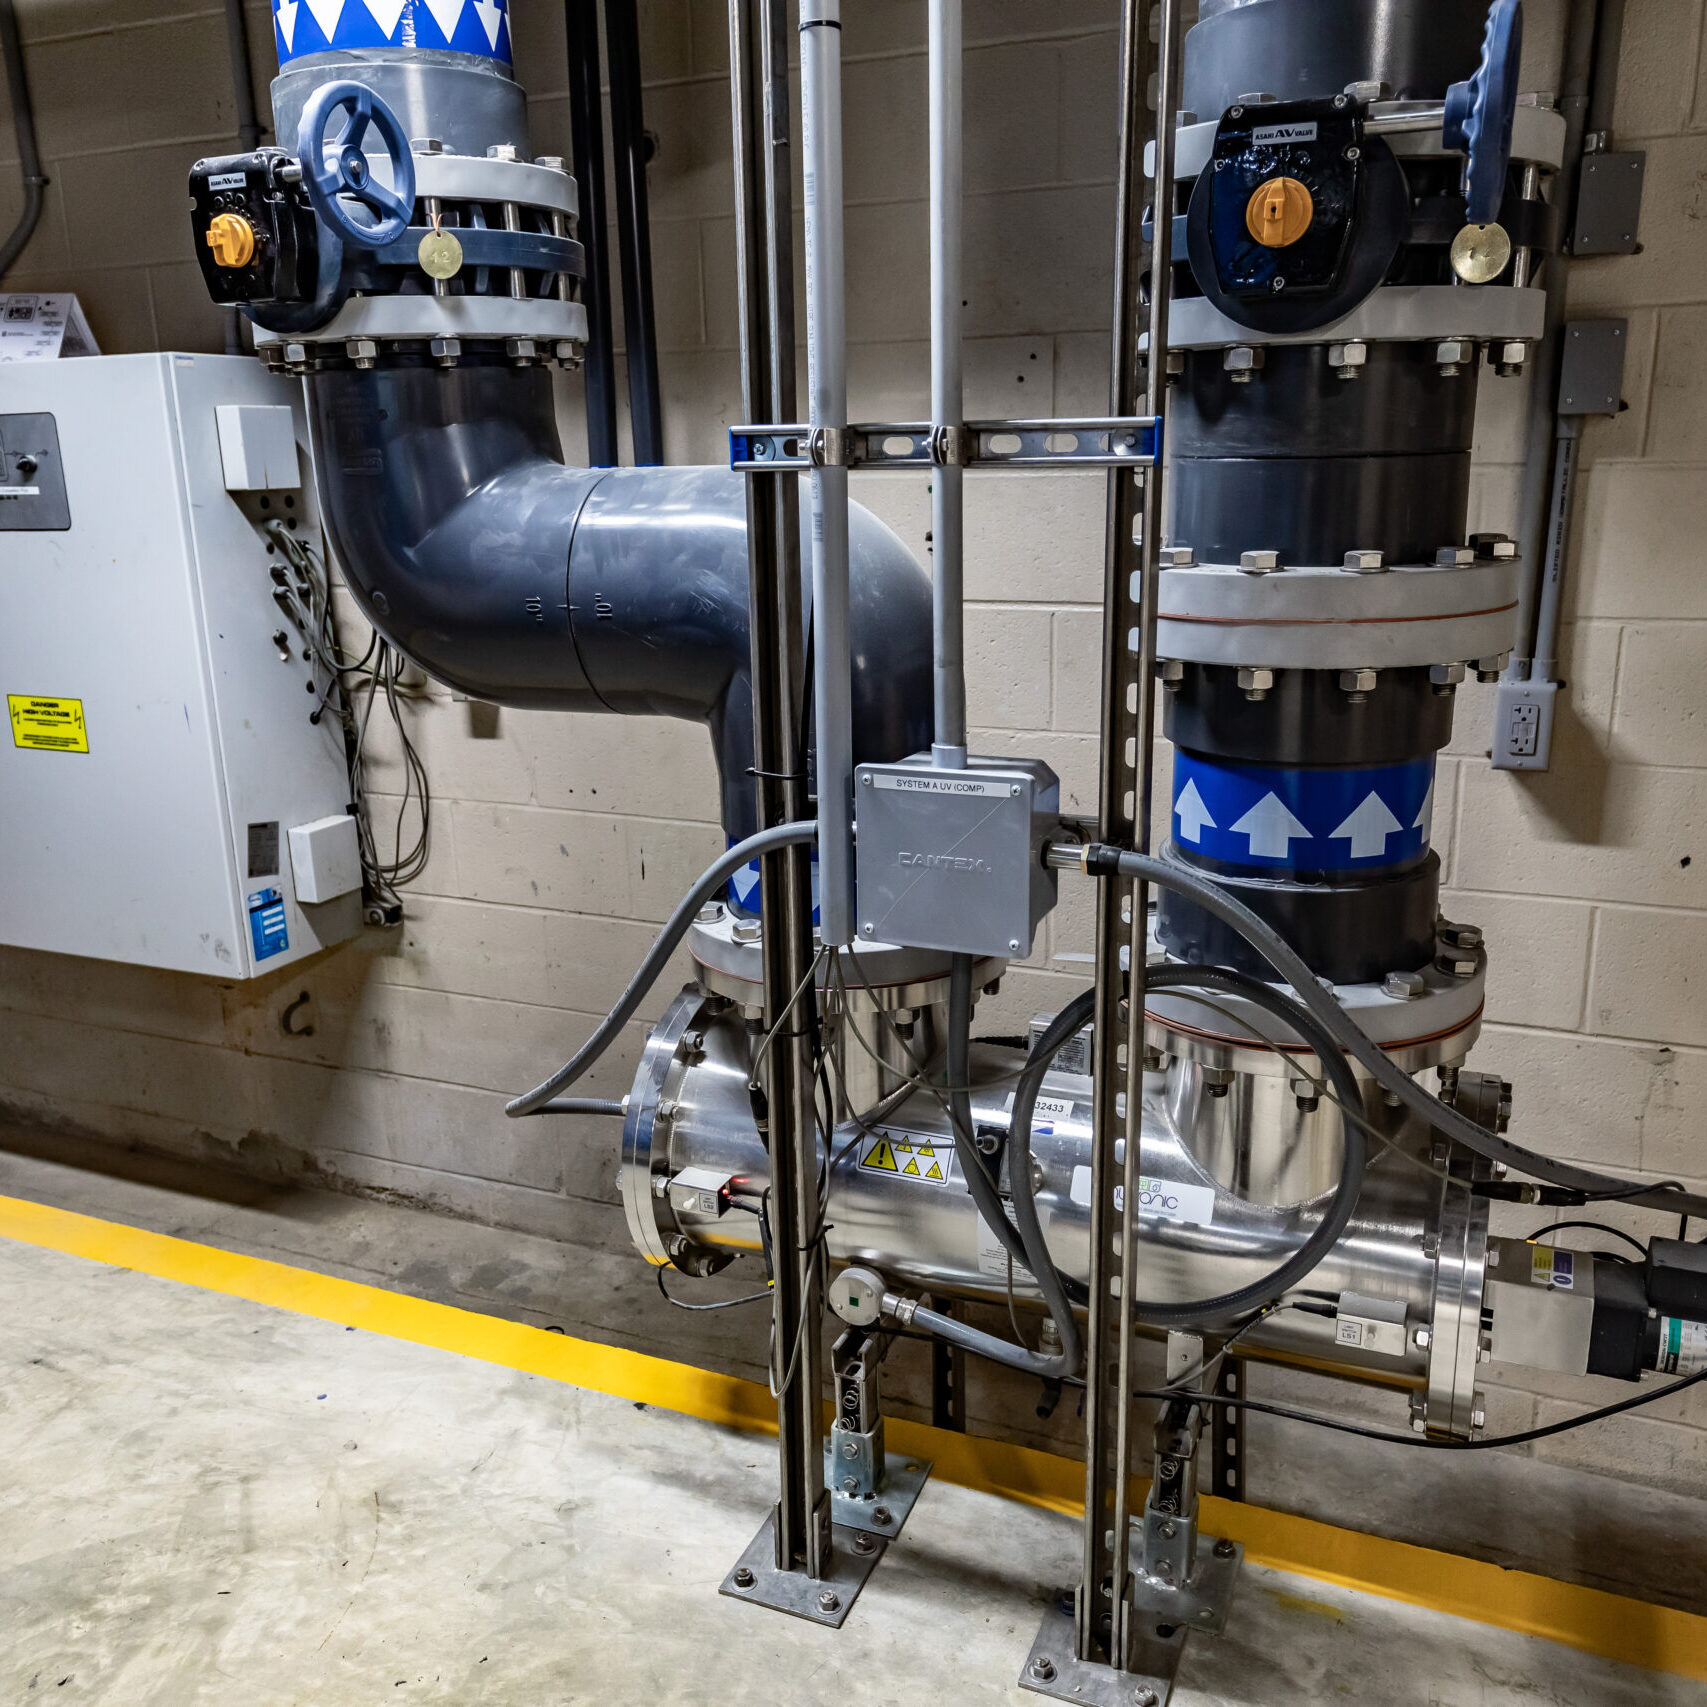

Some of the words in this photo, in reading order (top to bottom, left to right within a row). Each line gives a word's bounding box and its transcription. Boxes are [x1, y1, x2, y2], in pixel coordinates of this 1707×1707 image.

[1255, 132, 1274, 140] ASAHI
[1275, 128, 1295, 138] AV
[1294, 129, 1313, 137] VALVE
[896, 779, 930, 789] SYSTEM
[932, 781, 938, 789] A
[940, 782, 952, 791] UV
[953, 783, 985, 793] (COMP)
